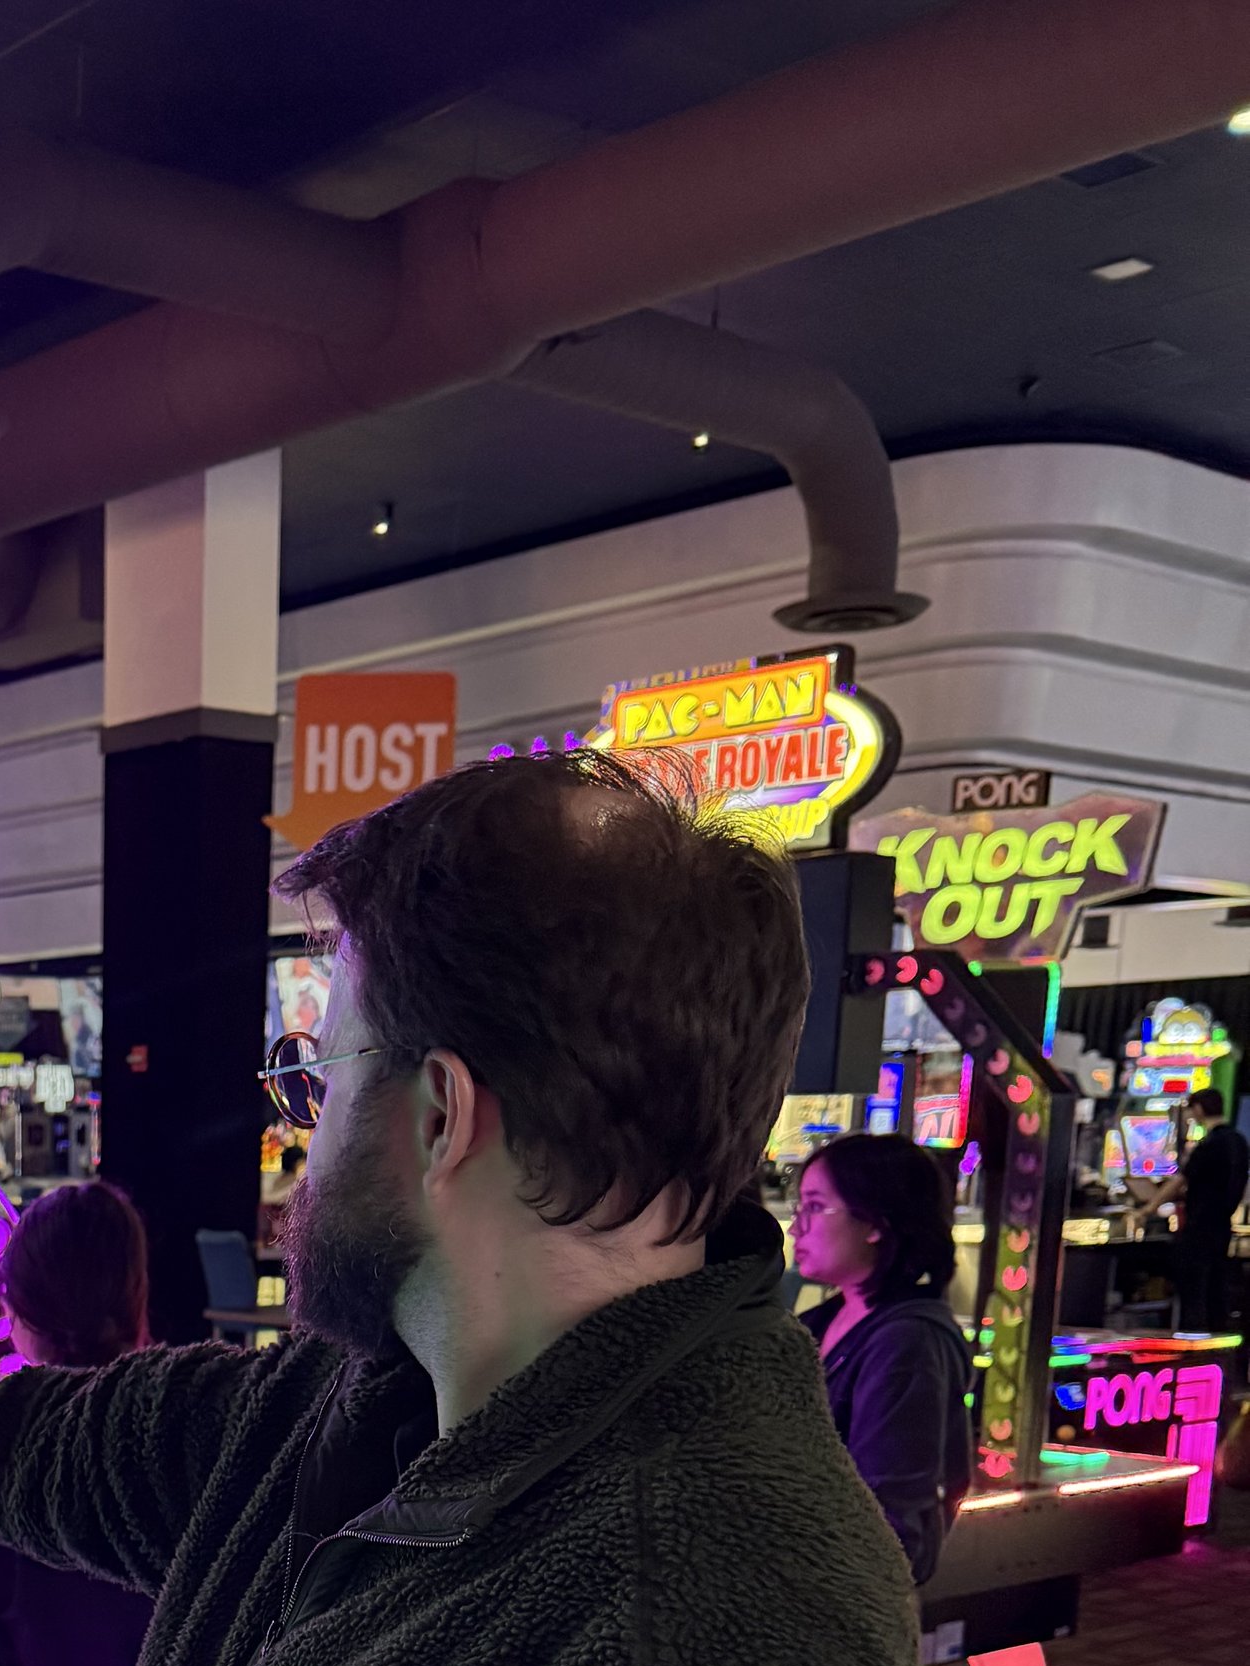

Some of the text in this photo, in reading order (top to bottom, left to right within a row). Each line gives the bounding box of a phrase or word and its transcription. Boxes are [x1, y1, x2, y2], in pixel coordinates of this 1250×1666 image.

[622, 671, 817, 744] PAC-MAN
[304, 722, 449, 794] HOST
[715, 721, 851, 793] ROYALE
[954, 770, 1040, 811] PONG
[876, 812, 1133, 894] KNOCK
[919, 876, 1085, 945] OUT
[1083, 1367, 1174, 1431] PONG
